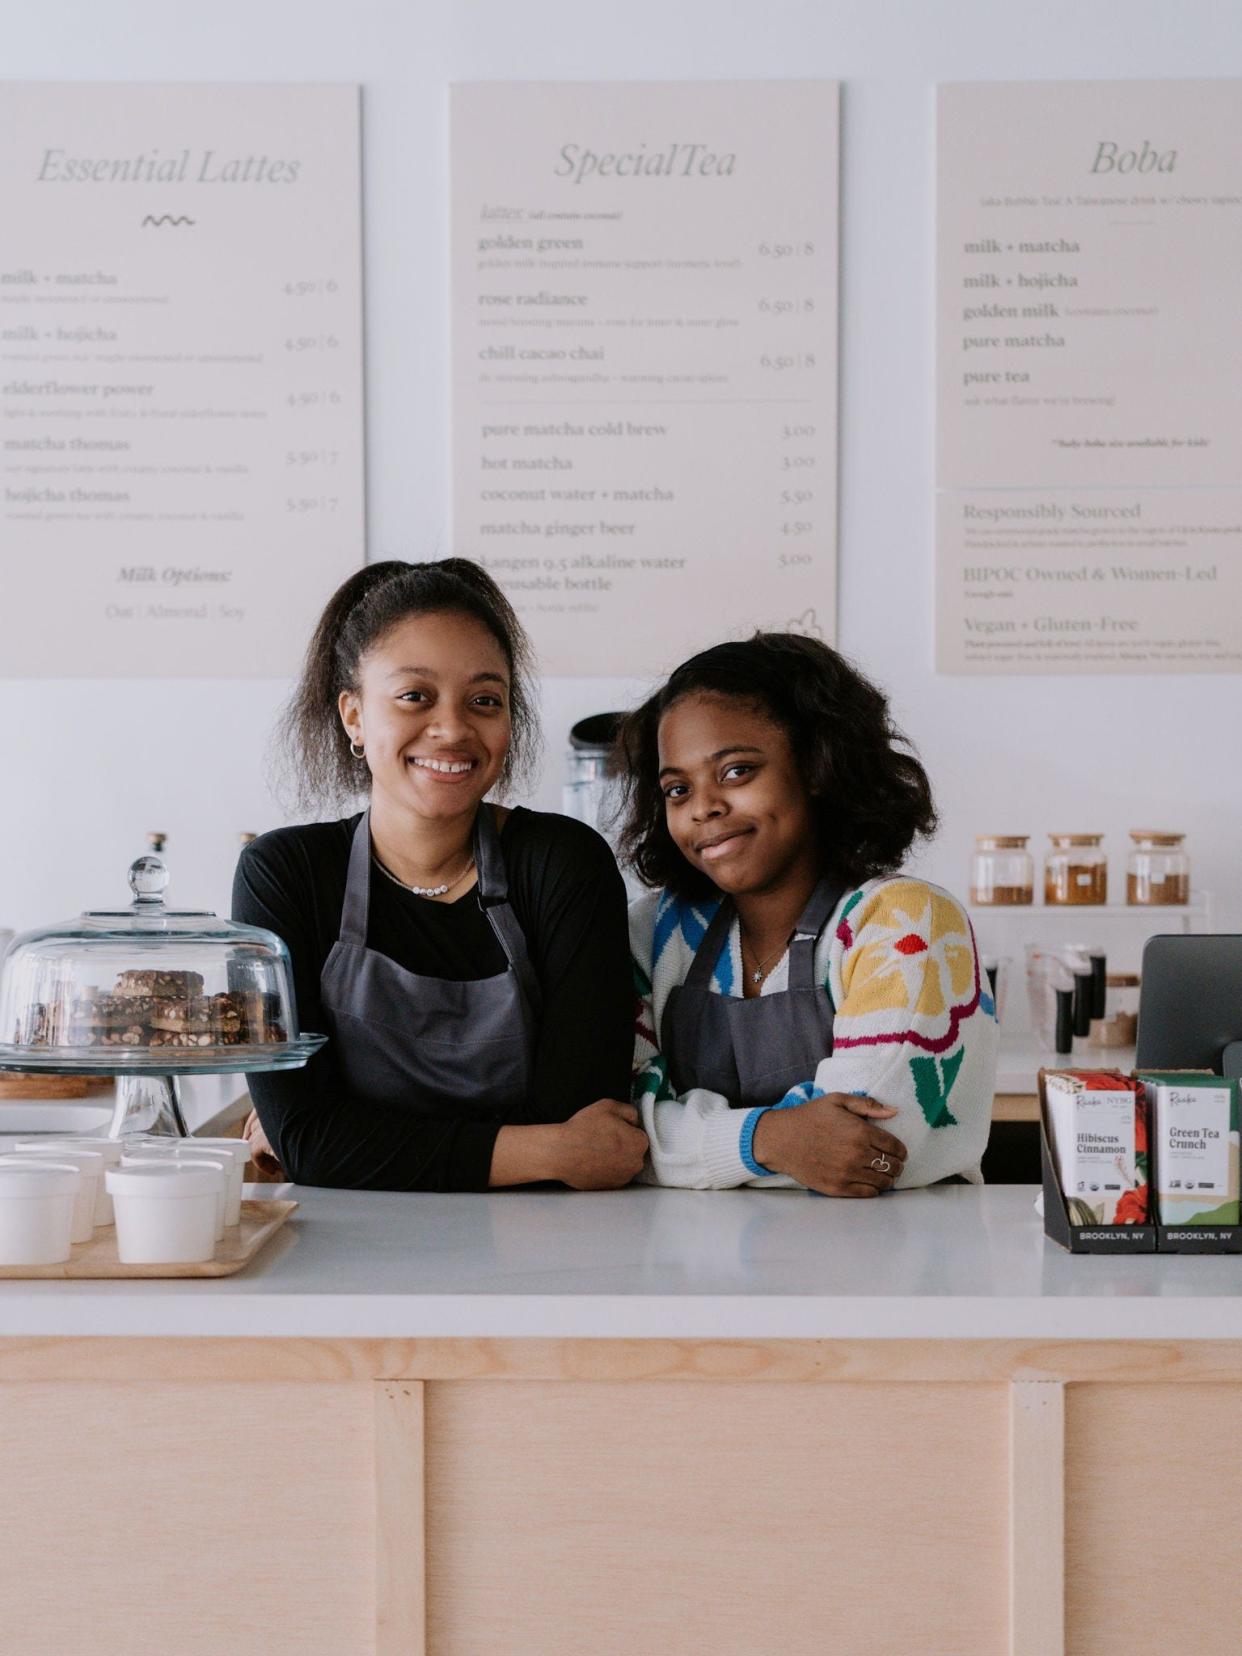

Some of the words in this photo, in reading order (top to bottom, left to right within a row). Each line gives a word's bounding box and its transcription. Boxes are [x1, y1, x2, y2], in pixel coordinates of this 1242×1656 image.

[37, 148, 191, 183] Essential
[196, 149, 302, 184] Lattes
[554, 142, 737, 185] SpecialTea
[1090, 139, 1179, 175] Boba
[478, 234, 533, 252] golden
[536, 238, 584, 254] green
[758, 241, 793, 259] 6.50
[803, 240, 815, 257] 8
[964, 238, 1002, 254] milk
[1019, 237, 1080, 253] matcha
[0, 268, 38, 286] milk
[55, 269, 118, 286] matcha
[963, 272, 1000, 288] milk
[1018, 271, 1079, 290] hojicha
[478, 295, 513, 306] rose
[516, 290, 589, 306] radiance
[758, 297, 794, 316] 6.50
[803, 297, 815, 312] 8
[963, 302, 1018, 322] golden
[1022, 301, 1059, 318] milk
[1, 325, 39, 342] milk
[56, 325, 118, 344] hojicha
[963, 337, 1000, 352] pure
[1004, 332, 1065, 348] matcha
[478, 344, 515, 360] chill
[518, 349, 567, 360] cacao
[569, 344, 605, 360] chai
[760, 354, 794, 371] 6.50
[804, 353, 817, 368] 8
[963, 371, 1001, 387] pure
[1005, 370, 1030, 383] tea
[2, 379, 99, 396] elderflower
[102, 383, 155, 399] power
[482, 425, 520, 440] pure
[523, 421, 585, 437] matcha
[588, 420, 623, 437] cold
[626, 421, 667, 437] brew
[782, 424, 816, 440] 3.00
[4, 436, 66, 451] matcha
[69, 436, 131, 451] thomas
[329, 450, 340, 466] 7
[481, 455, 508, 470] hot
[512, 455, 573, 470] matcha
[781, 455, 816, 471] 3.00
[4, 487, 66, 504] hojicha
[69, 486, 131, 503] thomas
[480, 488, 546, 501] coconut
[550, 488, 596, 501] water
[613, 486, 675, 501] matcha
[780, 490, 814, 506] 5.50
[328, 497, 339, 512] 7
[963, 502, 1066, 523] Responsibly
[1070, 501, 1142, 519] Sourced
[480, 519, 541, 535] matcha
[544, 520, 597, 538] ginger
[599, 519, 636, 536] beer
[780, 520, 814, 536] 4.50
[543, 557, 568, 573] 9.5
[571, 553, 637, 569] alkaline
[640, 557, 687, 569] water
[778, 553, 813, 570] 5.00
[117, 565, 157, 583] Milk
[161, 565, 232, 587] Options:
[963, 566, 1022, 582] BIPOC
[1025, 565, 1087, 582] Owned
[1091, 567, 1106, 581] &
[1110, 564, 1218, 582] Women-Led
[564, 575, 613, 591] bottle
[105, 604, 134, 619] Oat
[146, 603, 207, 619] Almond
[218, 603, 246, 622] Soy
[963, 617, 1016, 636] Vegan
[1033, 615, 1139, 632] Gluten-Free
[1077, 1133, 1120, 1143] Hibiscus
[1169, 1127, 1200, 1138] Green
[1201, 1127, 1220, 1139] Tea
[1077, 1144, 1127, 1154] Cinnamon
[1169, 1139, 1207, 1150] Crunch
[1080, 1232, 1130, 1241] BROOKLYN,
[1132, 1232, 1145, 1240] NY
[1167, 1232, 1217, 1241] BROOKLYN,
[1220, 1232, 1232, 1240] NY
